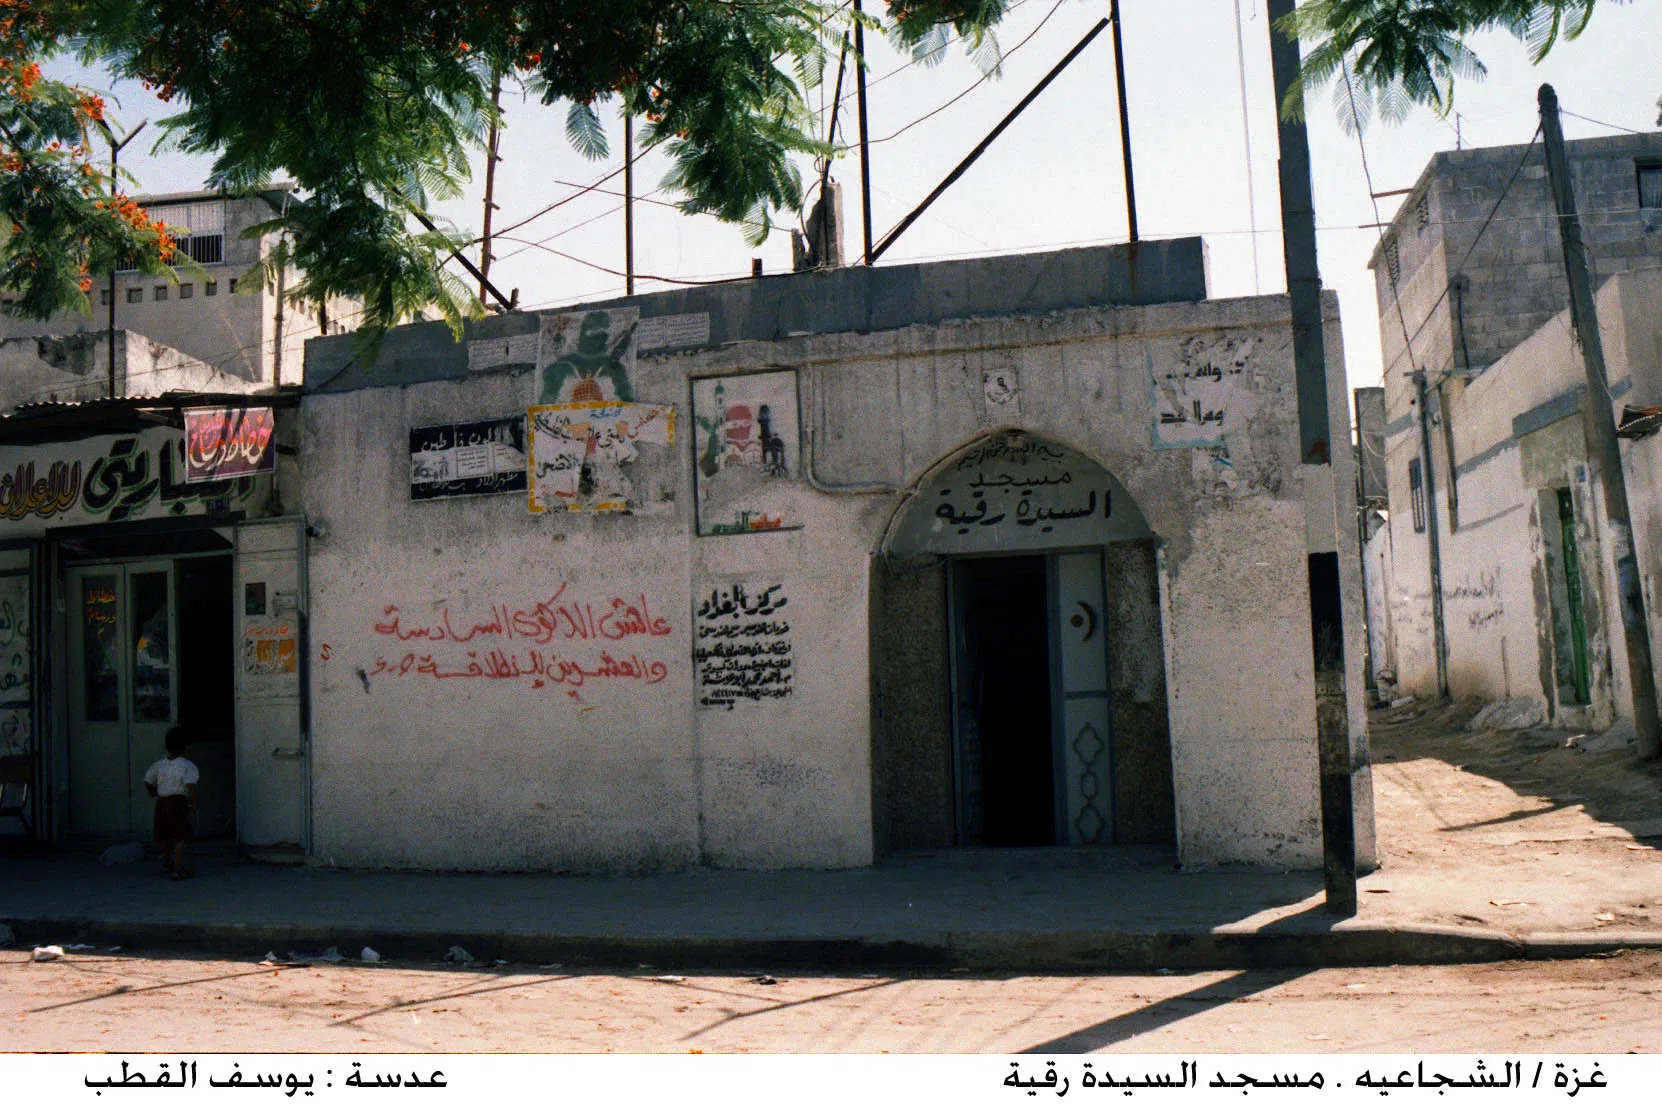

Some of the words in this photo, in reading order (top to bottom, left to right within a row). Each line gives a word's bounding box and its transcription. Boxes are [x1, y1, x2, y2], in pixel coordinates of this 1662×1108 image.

[968, 471, 1072, 495] مسجد
[935, 488, 1007, 536] رقية
[1015, 488, 1113, 534] السيدة
[373, 602, 513, 643] السادسة
